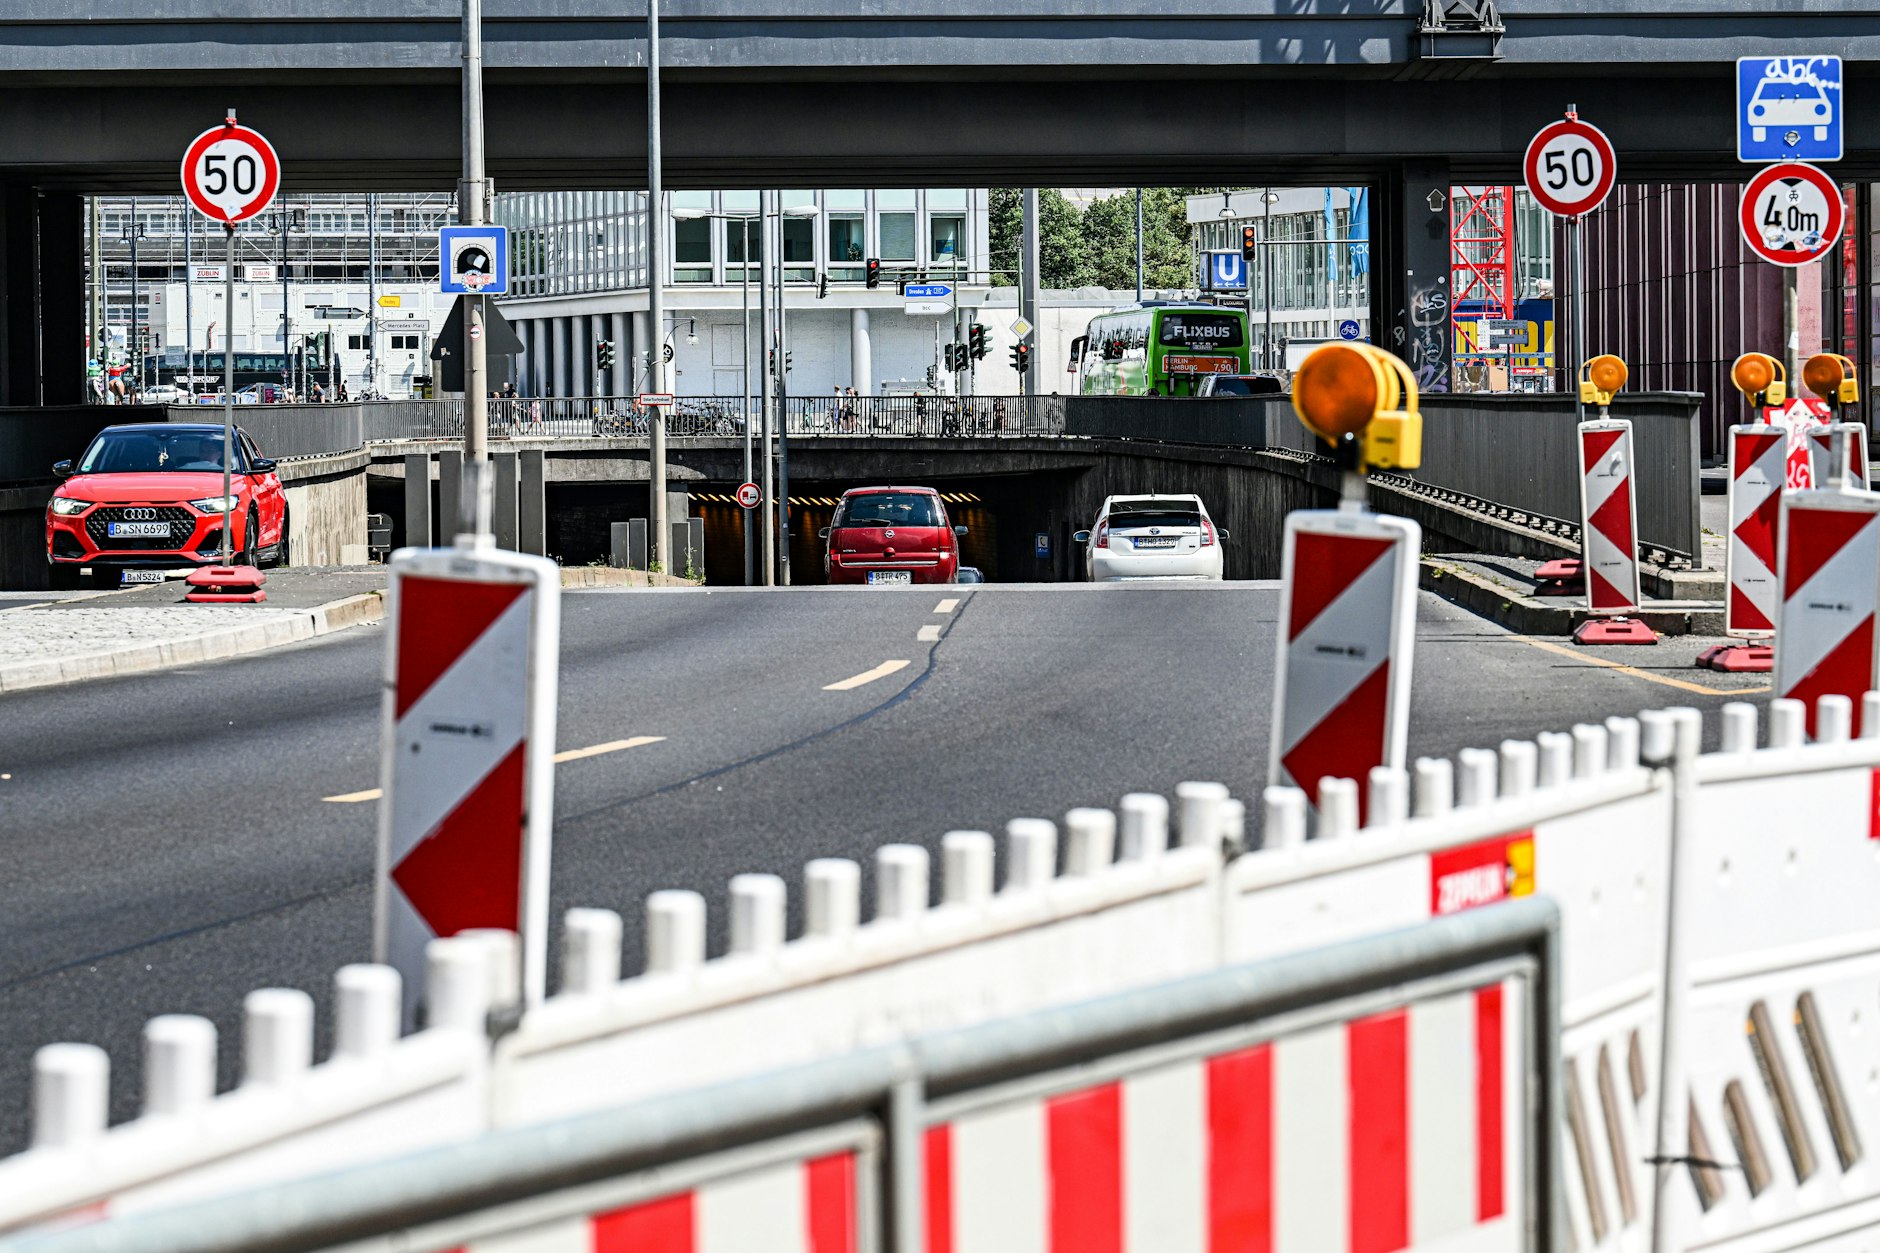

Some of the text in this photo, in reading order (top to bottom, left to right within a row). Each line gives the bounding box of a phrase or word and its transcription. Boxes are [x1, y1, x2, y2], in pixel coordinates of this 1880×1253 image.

[205, 155, 256, 195] 50
[1545, 148, 1594, 190] 50
[1219, 254, 1240, 282] U
[143, 524, 169, 534] 6699
